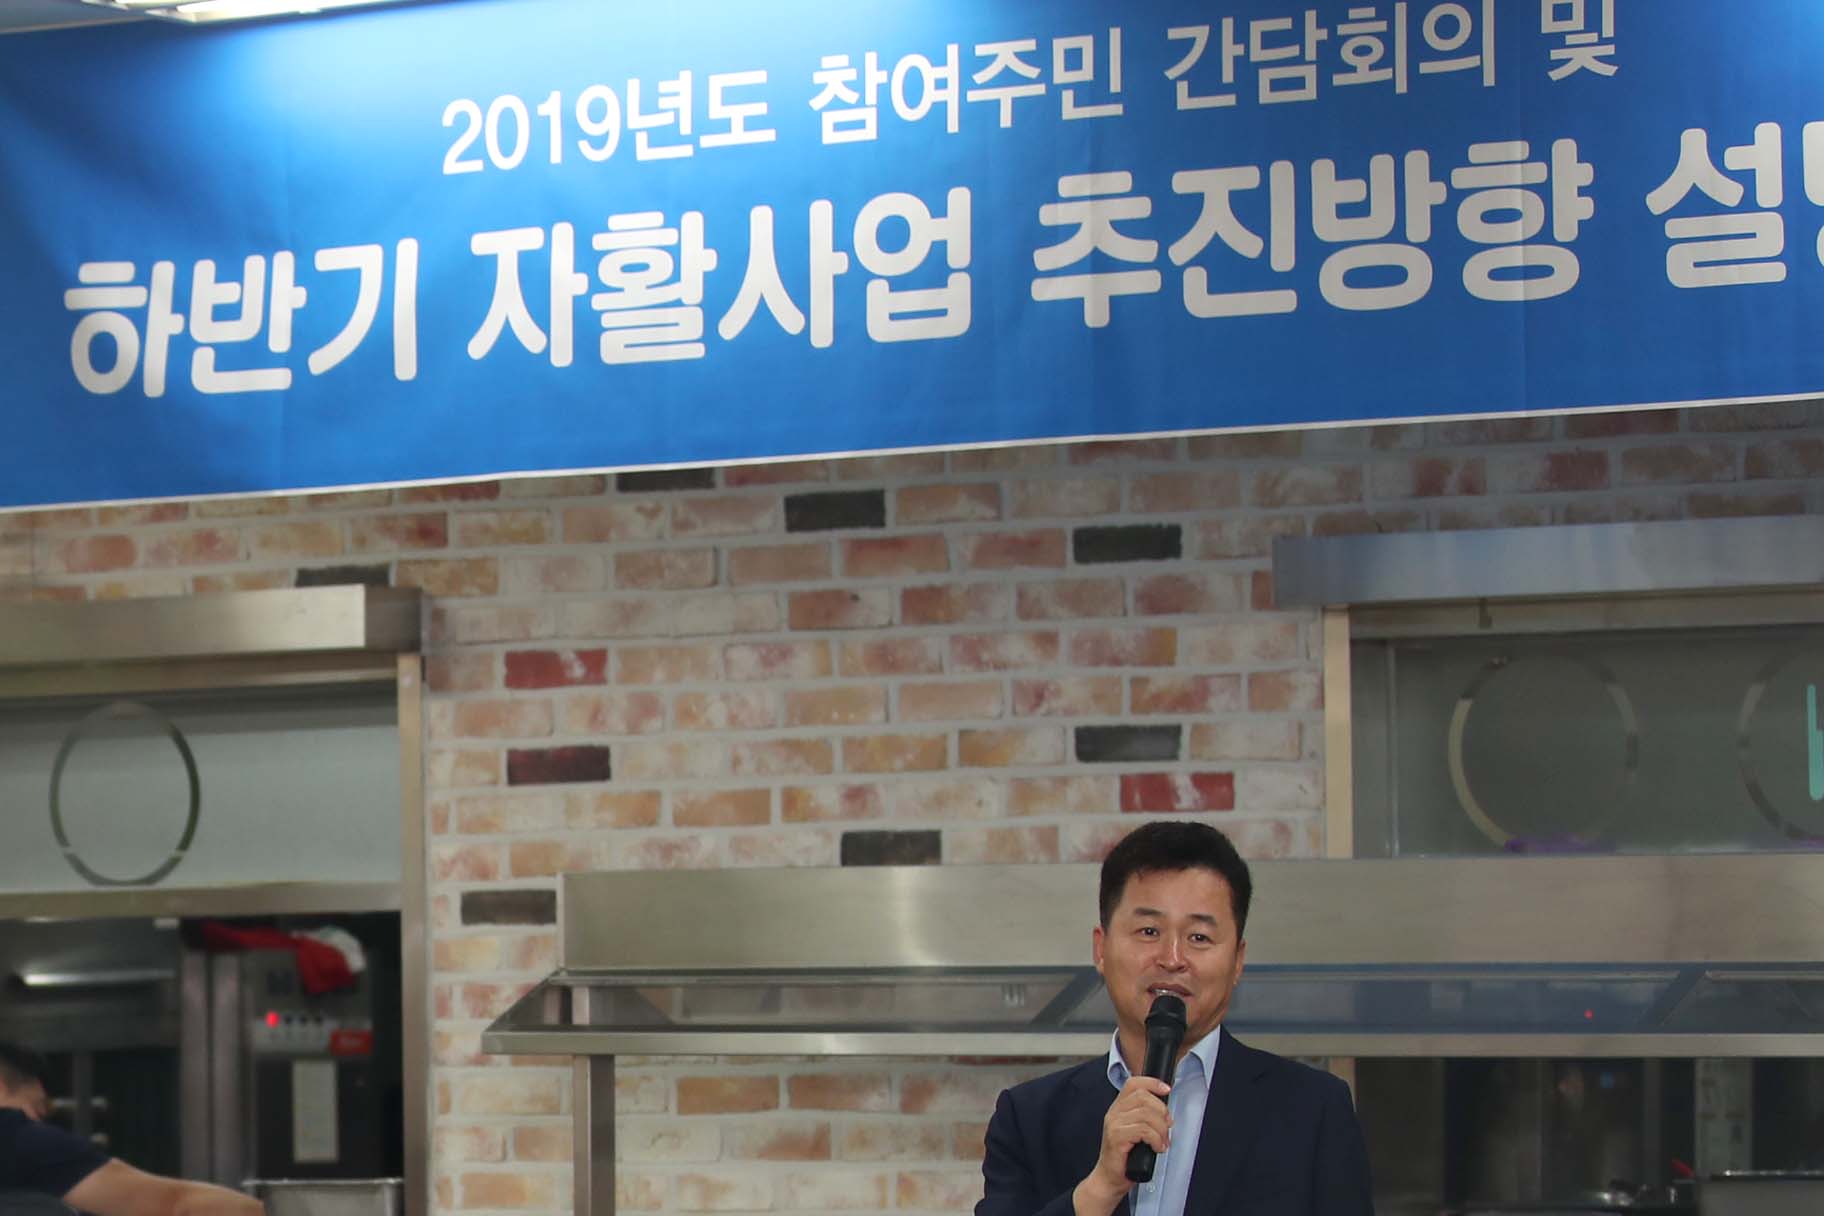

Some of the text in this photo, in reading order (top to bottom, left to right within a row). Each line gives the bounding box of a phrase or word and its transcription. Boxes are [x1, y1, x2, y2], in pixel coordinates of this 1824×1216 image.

[442, 0, 1619, 175] 2019년도 참여주민 간담회의 및
[63, 120, 1824, 399] 하반기 자활사업 추진방향 설
